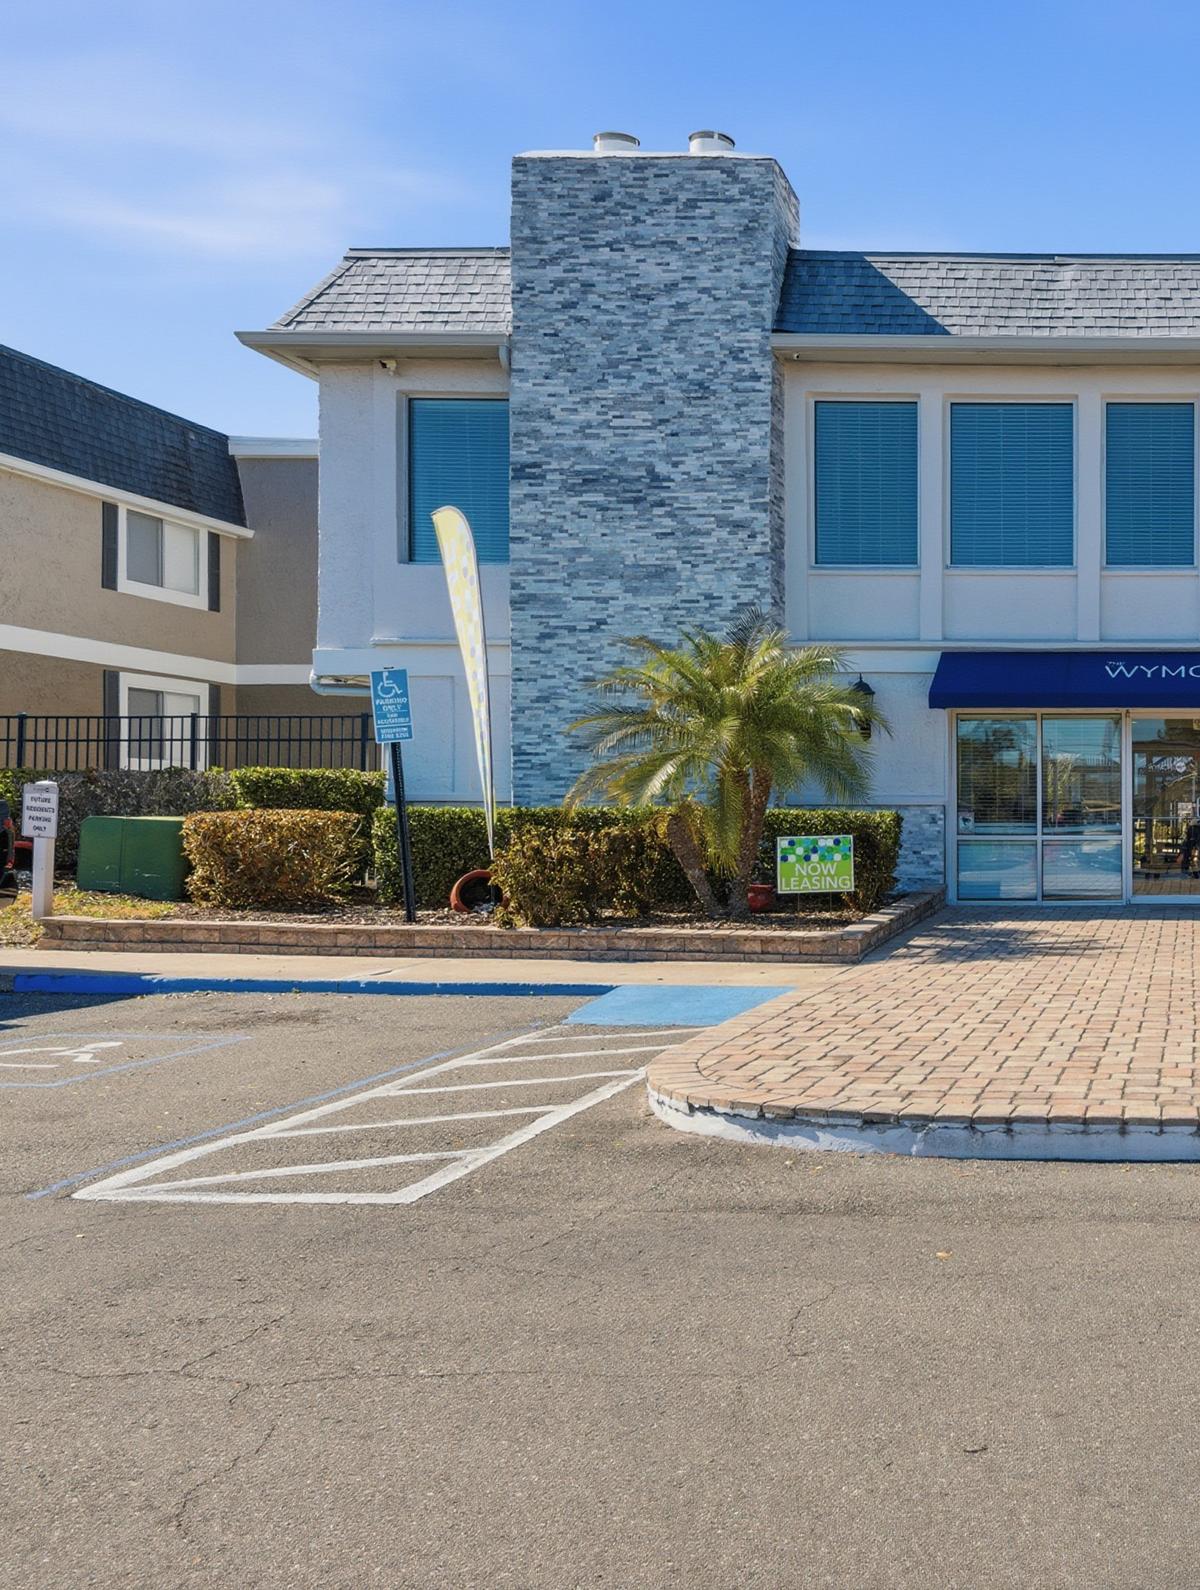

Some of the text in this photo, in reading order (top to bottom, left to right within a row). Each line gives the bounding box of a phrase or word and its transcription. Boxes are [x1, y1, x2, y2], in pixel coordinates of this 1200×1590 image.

[28, 815, 52, 823] PARKING
[32, 824, 47, 832] ONLY
[795, 862, 837, 877] NOW
[781, 875, 851, 891] LEASING
